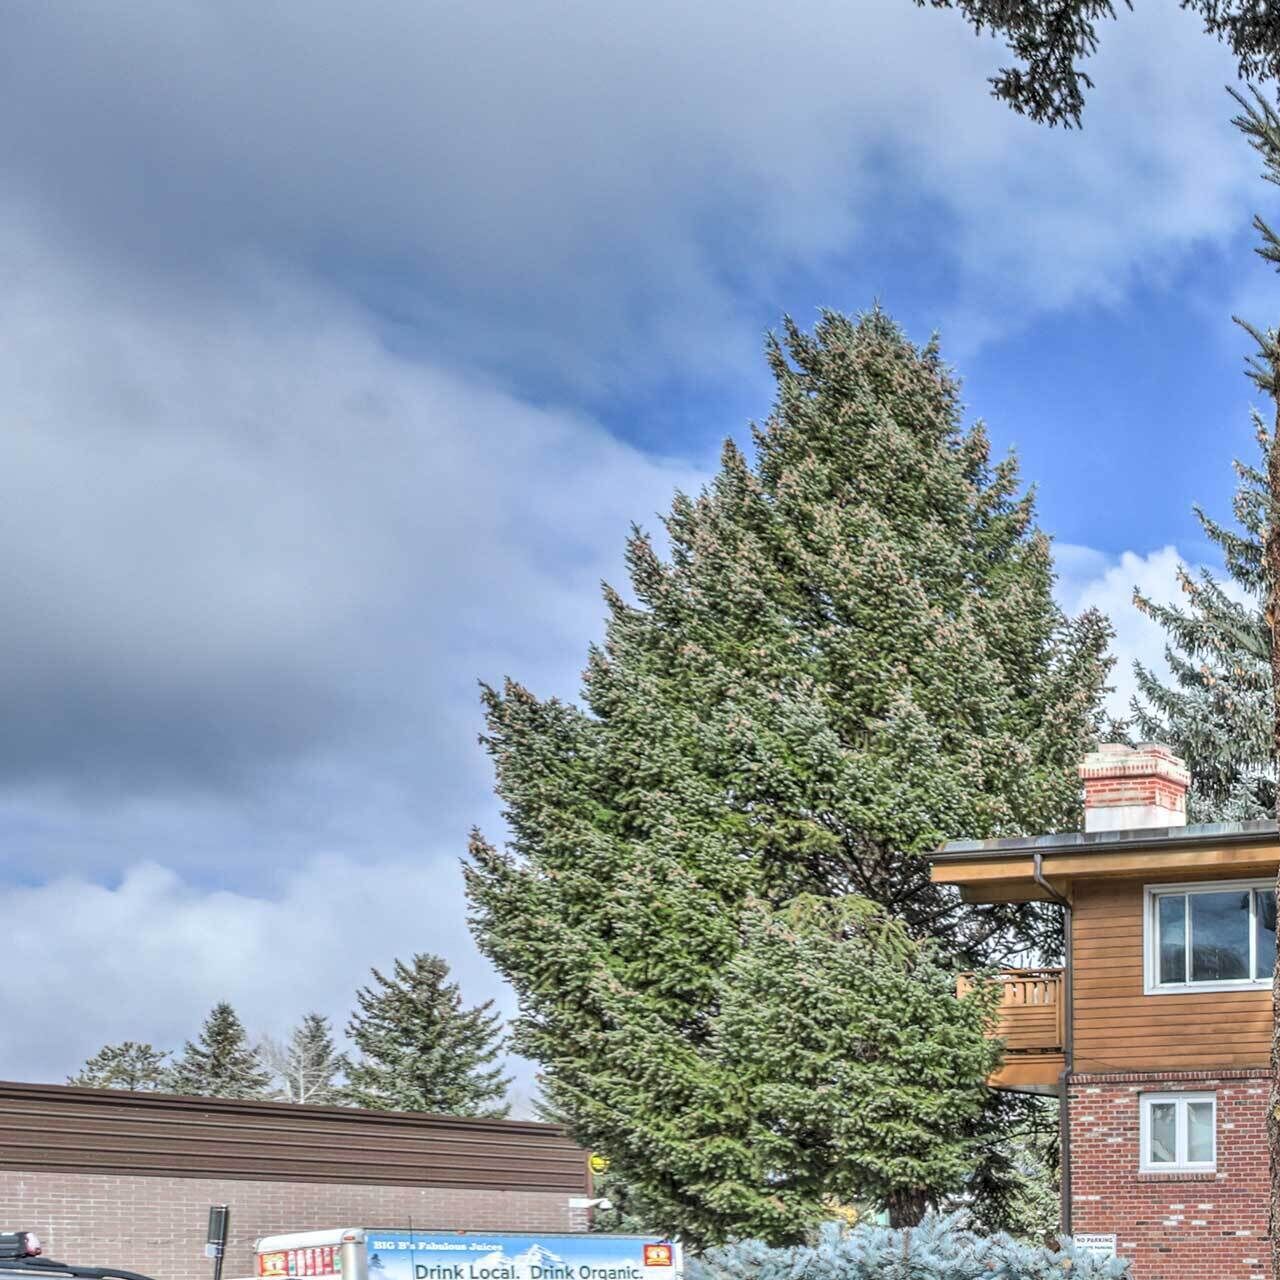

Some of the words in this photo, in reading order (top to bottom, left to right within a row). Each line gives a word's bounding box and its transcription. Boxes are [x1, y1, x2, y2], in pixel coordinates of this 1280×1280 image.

[374, 1240, 395, 1250] BIG
[398, 1241, 416, 1250] B's
[418, 1242, 467, 1251] Fabulous
[469, 1242, 503, 1251] Juices
[415, 1264, 464, 1280] Drink
[470, 1264, 520, 1280] Local.
[530, 1265, 575, 1280] Drink
